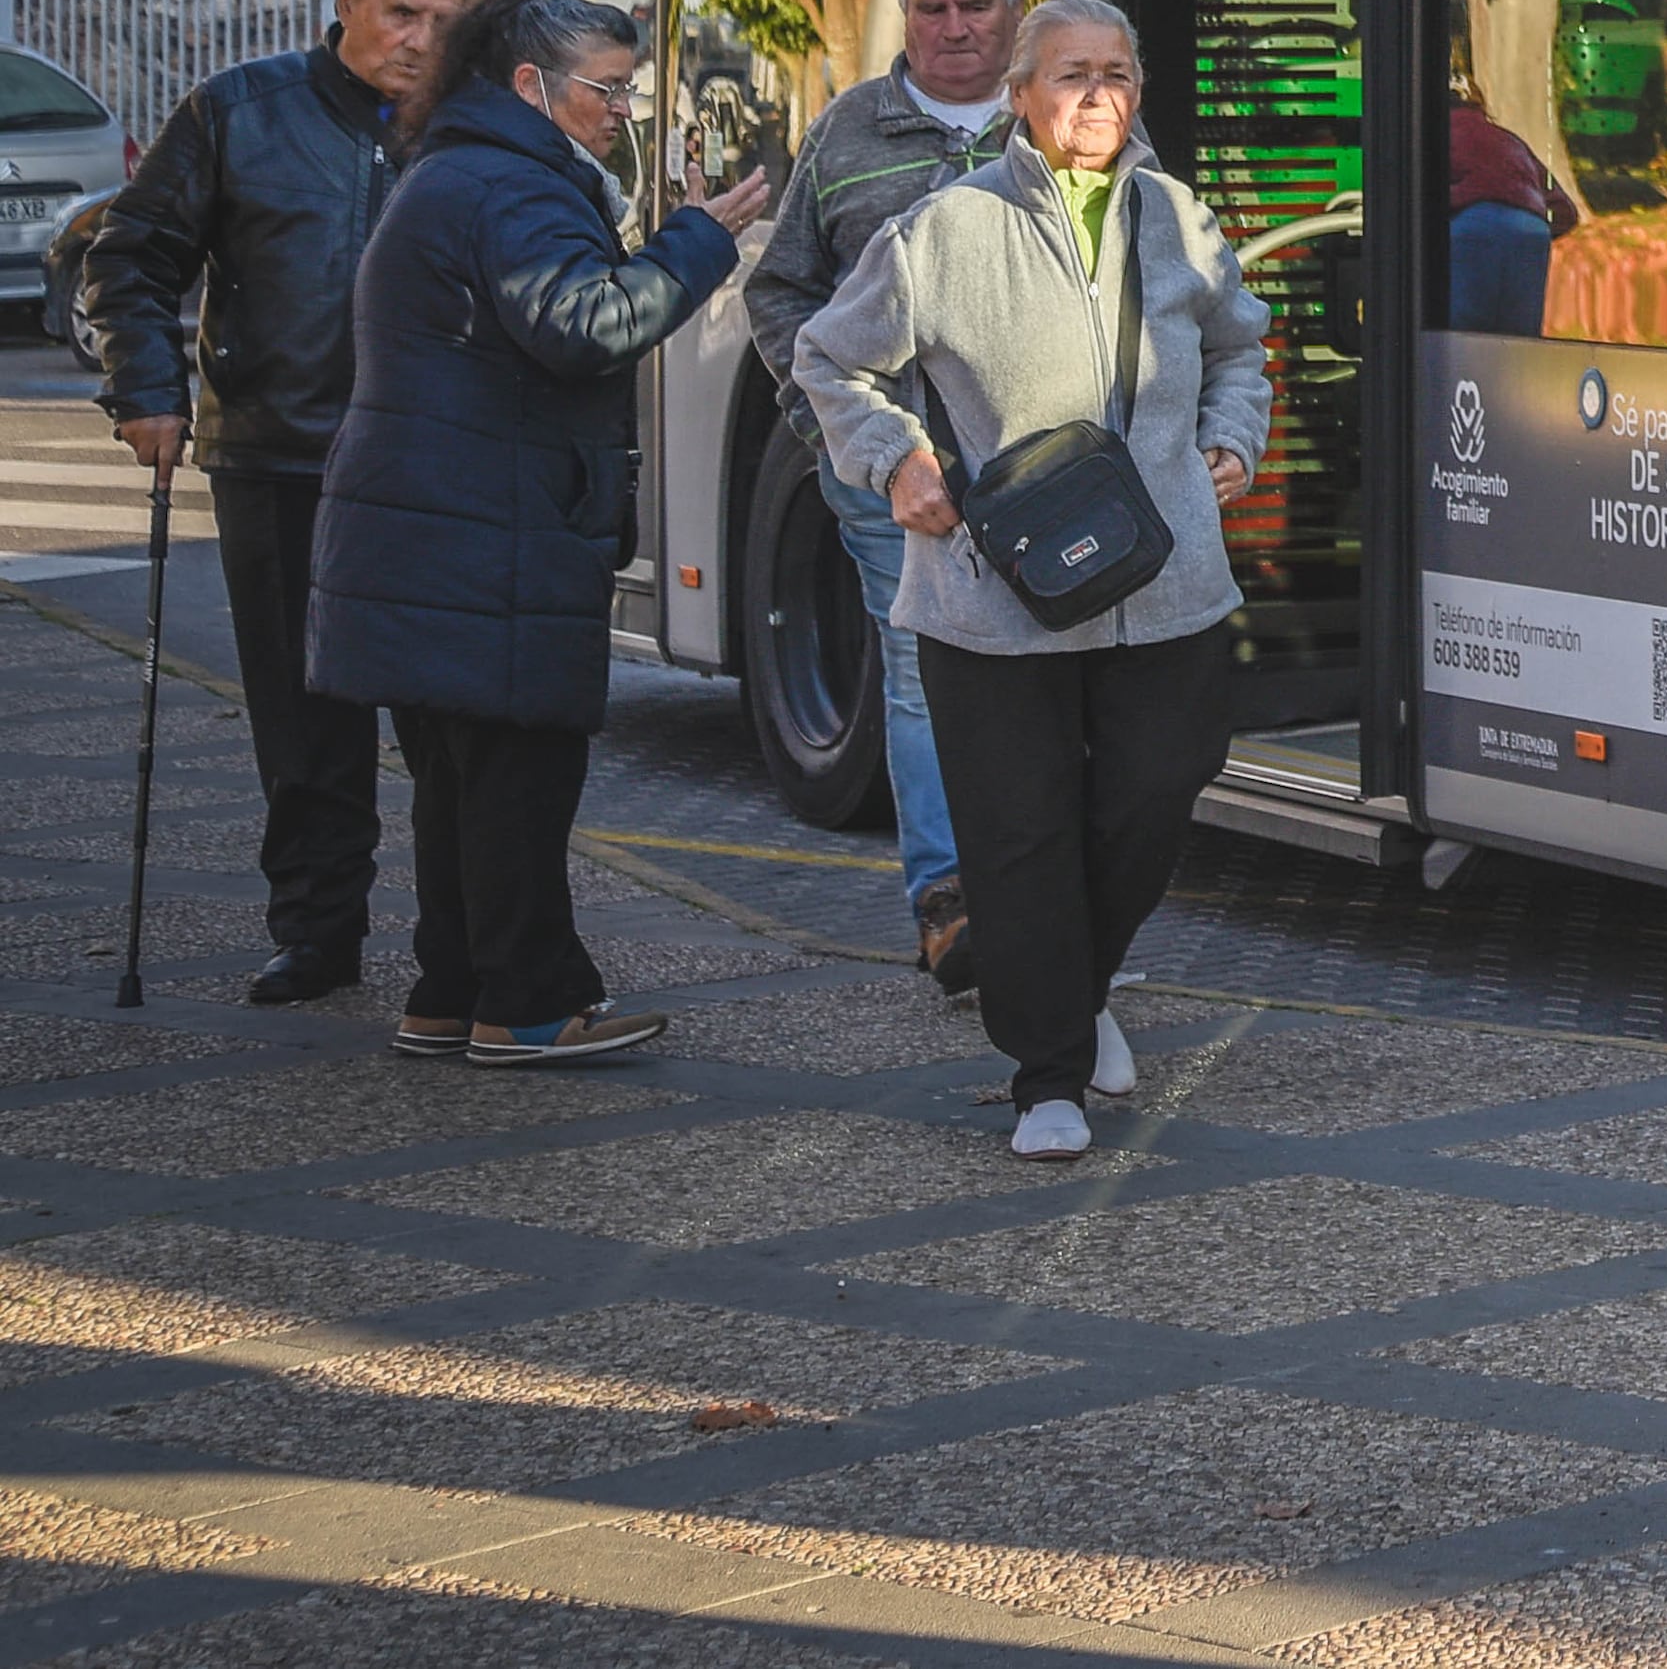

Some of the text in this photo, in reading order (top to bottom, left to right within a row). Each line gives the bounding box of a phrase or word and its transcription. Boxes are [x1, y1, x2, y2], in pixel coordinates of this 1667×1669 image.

[1611, 392, 1640, 438] Sé
[1431, 462, 1508, 498] Acogimiento
[1631, 449, 1661, 494] DE
[1446, 496, 1491, 526] familiar
[1432, 602, 1582, 652] Teléfono de información
[1433, 637, 1521, 679] 608 388 539
